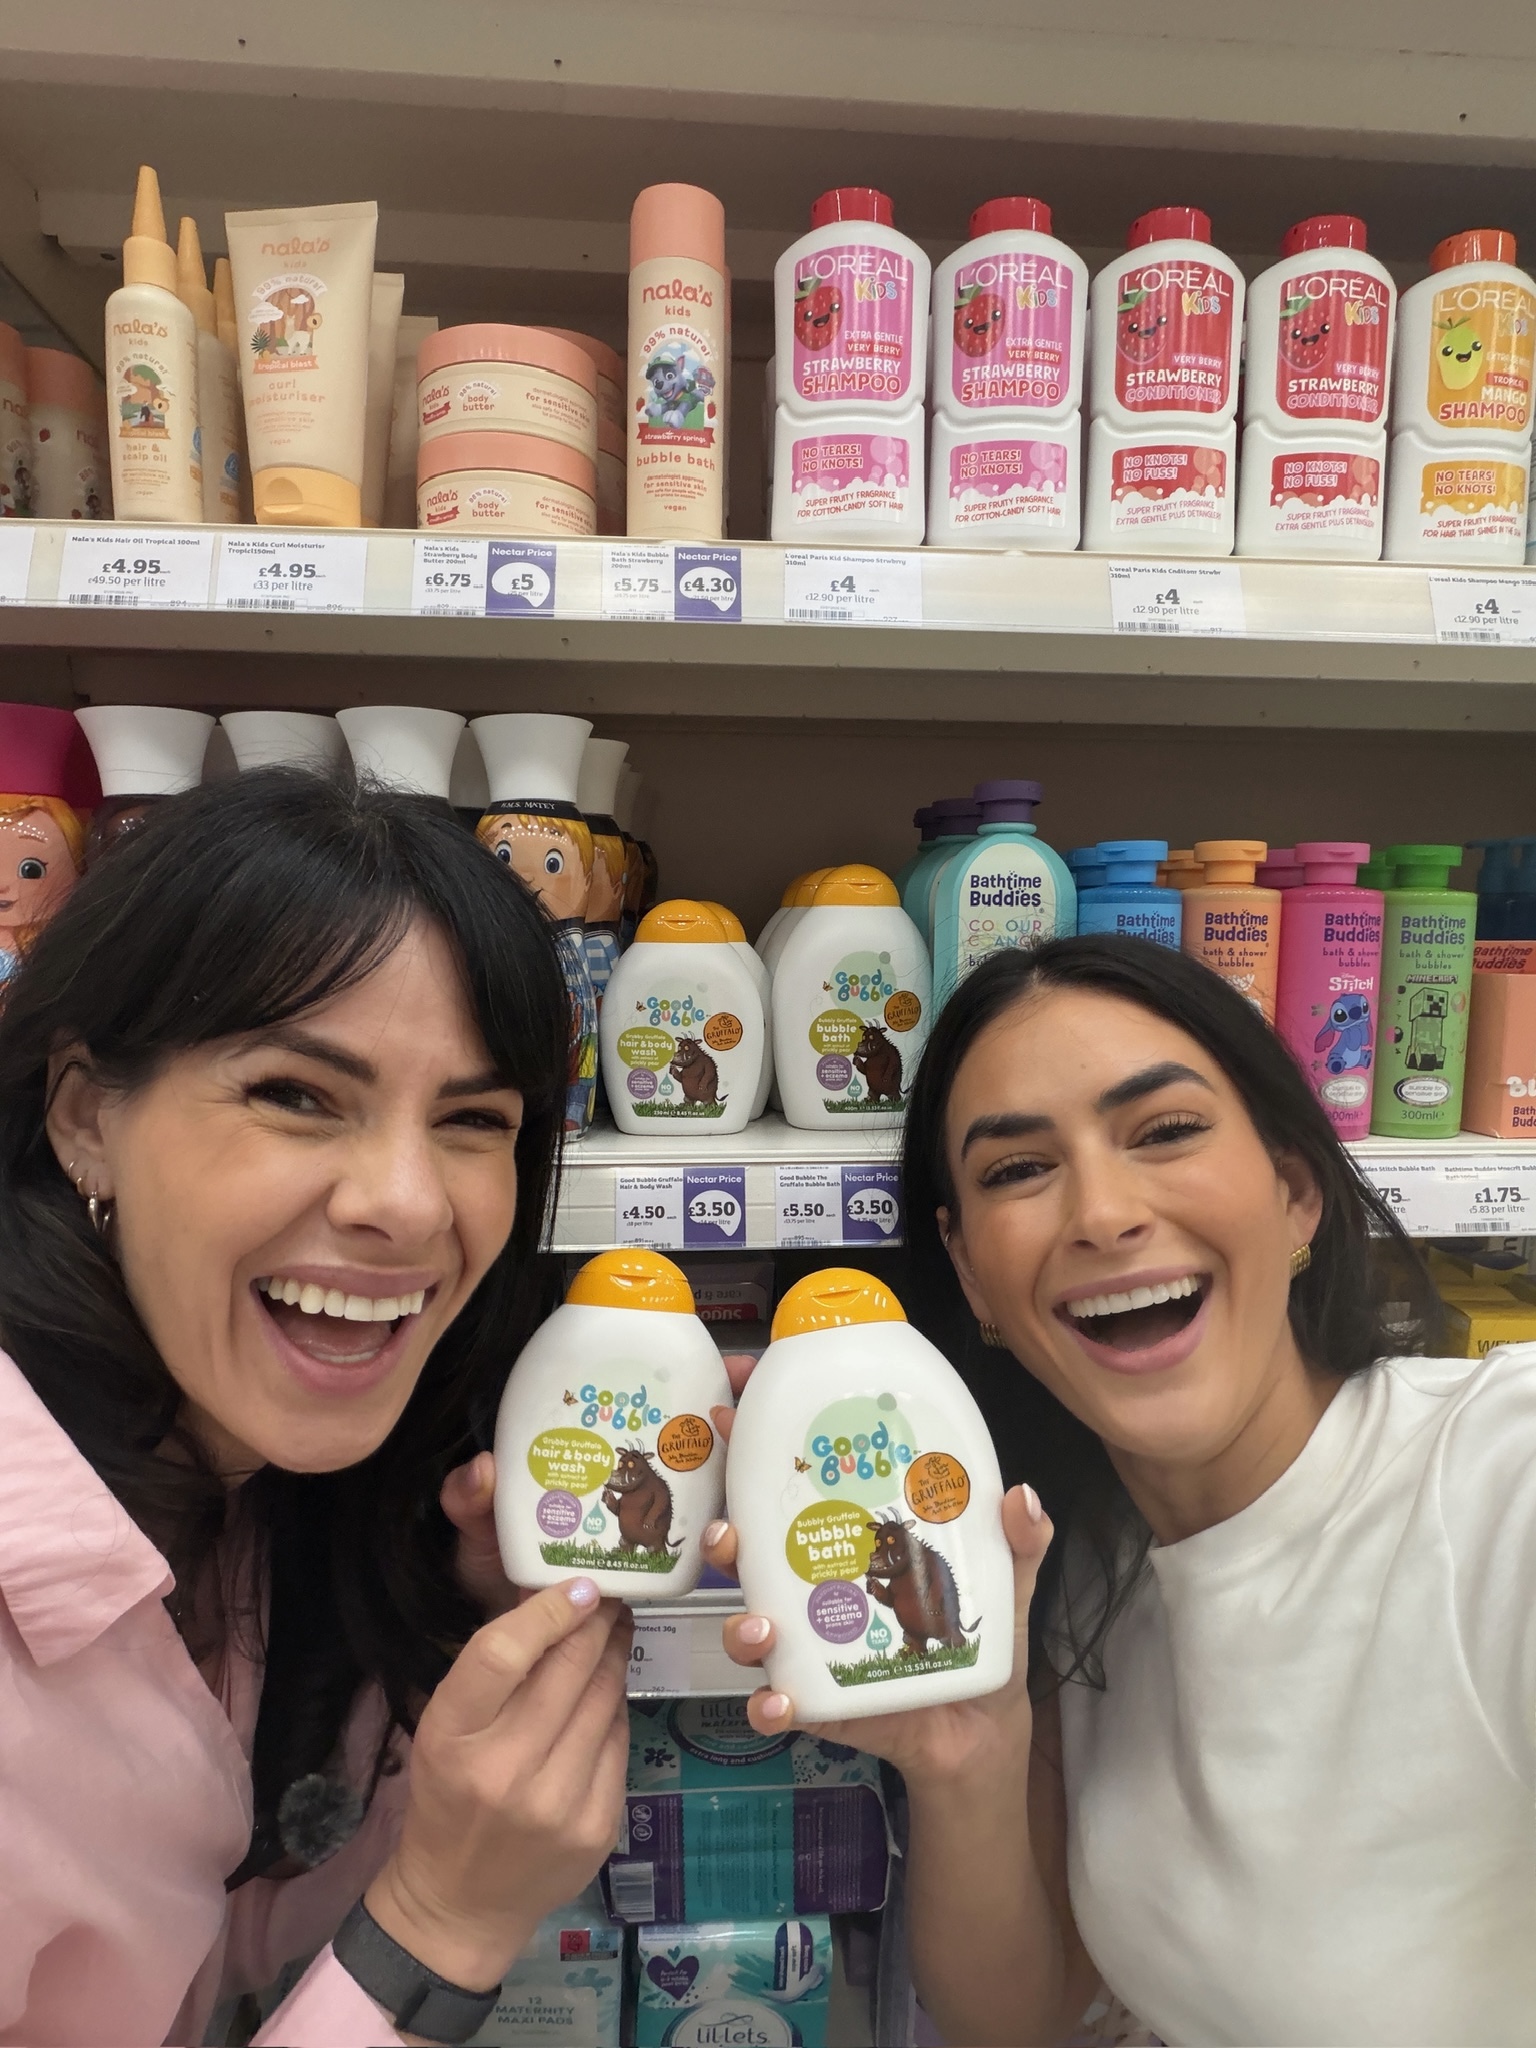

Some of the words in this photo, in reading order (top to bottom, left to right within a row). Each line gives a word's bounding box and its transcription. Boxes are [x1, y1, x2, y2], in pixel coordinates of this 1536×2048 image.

[261, 236, 331, 256] nala's
[800, 252, 908, 282] L'ORÉAL
[959, 259, 1068, 290] L'ORÉAL
[1124, 267, 1230, 297] L'ORÉAL
[643, 279, 713, 307] nala's
[1287, 276, 1387, 308] L'ORÉAL
[665, 305, 691, 317] kids
[112, 318, 169, 338] nala's
[128, 337, 149, 347] kids
[643, 330, 666, 353] 99%
[669, 327, 711, 357] natural
[844, 330, 872, 340] EXTRA
[875, 331, 904, 344] GENTLE
[847, 343, 871, 352] VERY
[873, 344, 901, 356] BERRY
[803, 357, 901, 376] STRAWBERRY
[1174, 355, 1196, 365] VERY
[1199, 356, 1222, 368] BERRY
[962, 363, 1061, 383] STRAWBERRY
[1126, 368, 1222, 388] STRAWBERRY
[268, 379, 297, 391] curl
[802, 372, 901, 395] SHAMPOO
[961, 379, 1061, 402] SHAMPOO
[1288, 377, 1379, 398] STRAWBERRY
[422, 385, 451, 406] nala's
[467, 394, 489, 405] body
[1125, 385, 1222, 405] CONDITIONER
[1481, 386, 1527, 406] MANGO
[462, 401, 495, 412] butter
[1287, 393, 1378, 415] CONDITIONER
[1440, 402, 1526, 426] SHAMPOO
[644, 431, 682, 443] strawberry
[682, 433, 707, 445] springs
[126, 442, 148, 453] hair
[802, 446, 819, 460] NO
[822, 443, 862, 457] TEARS!
[122, 451, 149, 463] scalp
[152, 452, 168, 462] oil
[636, 452, 682, 467] bubble
[687, 453, 716, 471] bath
[802, 460, 819, 473] NO
[821, 457, 864, 471] KNOTS!
[1124, 455, 1143, 469] NO
[1144, 453, 1188, 467] KNOTS!
[1123, 469, 1143, 483] NO
[1144, 467, 1178, 481] FUSS!
[1435, 470, 1454, 483] NO
[1457, 469, 1497, 482] TEARS!
[805, 496, 828, 508] SUPER
[829, 492, 854, 504] FRUITY
[856, 489, 896, 500] FRAGRANCE
[1434, 484, 1453, 497] NO
[1456, 484, 1497, 495] KNOTS!
[664, 503, 687, 512] vegan
[797, 508, 811, 518] FOR
[812, 501, 866, 517] COTTON-CANDY
[868, 500, 887, 509] SOFT
[889, 501, 904, 511] HAIR
[72, 536, 95, 544] Nala's
[96, 537, 114, 545] Kids
[115, 538, 131, 546] Hair
[133, 538, 143, 546] Oil
[144, 538, 176, 547] Tropical
[492, 547, 524, 557] Nectar
[527, 548, 553, 558] Price
[678, 552, 710, 562] Nectar
[712, 553, 738, 563] Price
[809, 554, 828, 562] Paris
[843, 556, 875, 564] Shampoo
[102, 558, 161, 575] £4.95
[123, 579, 142, 589] per
[144, 576, 166, 588] litre
[425, 572, 471, 588] £6.75
[511, 573, 534, 591] £5
[614, 578, 659, 593] £5.75
[684, 576, 735, 593] £4.30
[830, 575, 856, 593] £4
[836, 595, 852, 604] per
[854, 594, 875, 604] litre
[1155, 588, 1180, 605] £4
[1475, 598, 1500, 615] £4
[524, 801, 556, 810] MATEY
[970, 873, 1042, 890] Bathtime
[970, 890, 1041, 907] Buddies
[1117, 913, 1175, 928] Bathtime
[1205, 911, 1268, 927] Bathtime
[1325, 912, 1381, 928] Bathtime
[1401, 915, 1466, 930] Bathtime
[1204, 927, 1268, 942] Buddies
[1324, 928, 1380, 943] Buddies
[1400, 930, 1465, 944] Buddies
[1203, 947, 1223, 956] bath
[1239, 949, 1267, 957] shower
[1474, 946, 1533, 958] Bathtime
[1218, 957, 1254, 967] bubbles
[1406, 974, 1458, 984] MINECRAFT
[647, 995, 693, 1011] Good
[650, 1007, 705, 1026] Bubble
[620, 1039, 638, 1048] hair
[640, 1040, 647, 1048] &
[647, 1040, 673, 1051] body
[687, 1175, 717, 1184] Nectar
[719, 1175, 742, 1184] Price
[845, 1173, 874, 1183] Nectar
[876, 1173, 899, 1183] Price
[1475, 1187, 1521, 1203] £1.75
[623, 1205, 665, 1220] £4.50
[688, 1201, 736, 1217] £3.50
[783, 1203, 825, 1217] £5.50
[847, 1200, 893, 1215] £3.50
[1491, 1206, 1506, 1214] per
[1507, 1205, 1525, 1213] litre
[580, 1384, 648, 1409] Good
[581, 1403, 662, 1432] Bubble
[811, 1421, 890, 1458] Good
[532, 1445, 561, 1458] hair
[564, 1448, 573, 1461] &
[574, 1449, 611, 1467] body
[820, 1441, 913, 1486] Bubble
[548, 1461, 586, 1474] wash
[911, 1475, 966, 1506] GRUFFALO
[586, 1517, 603, 1526] NO
[797, 1516, 825, 1529] Bubbly
[827, 1511, 861, 1524] Gruffalo
[796, 1522, 863, 1546] bubble
[808, 1540, 856, 1562] bath
[811, 1568, 838, 1581] prickly
[840, 1565, 860, 1577] pear
[816, 1602, 859, 1616] sensitive
[824, 1611, 863, 1624] eczema
[662, 1625, 676, 1633] 30g
[870, 1628, 888, 1639] NO
[528, 1996, 542, 2005] 12
[495, 2005, 575, 2015] MATERNITY
[498, 2015, 535, 2024] MAXI
[538, 2016, 574, 2025] PADS
